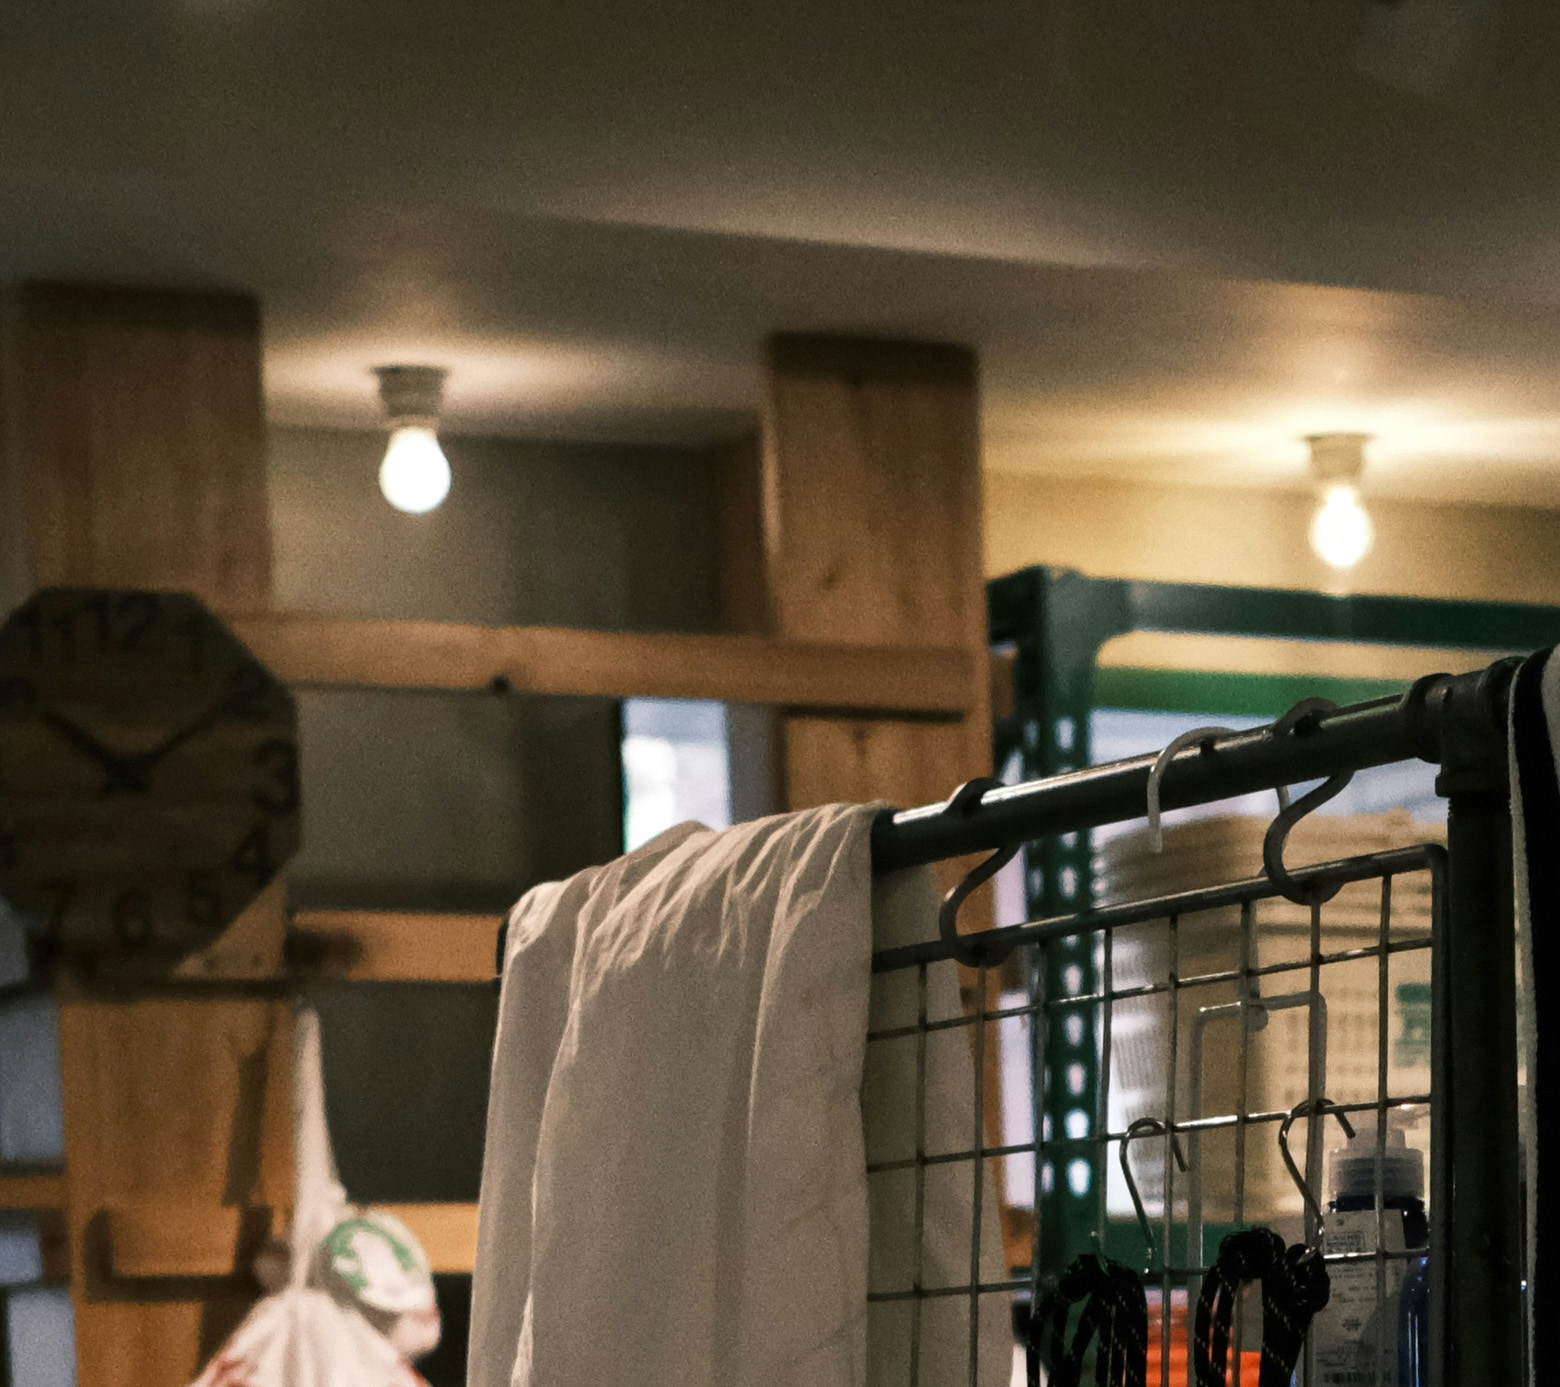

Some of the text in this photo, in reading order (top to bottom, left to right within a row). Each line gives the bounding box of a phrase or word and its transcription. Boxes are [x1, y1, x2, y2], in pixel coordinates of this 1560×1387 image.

[251, 738, 298, 817] 3
[234, 820, 276, 883] 4
[111, 885, 153, 949] 6
